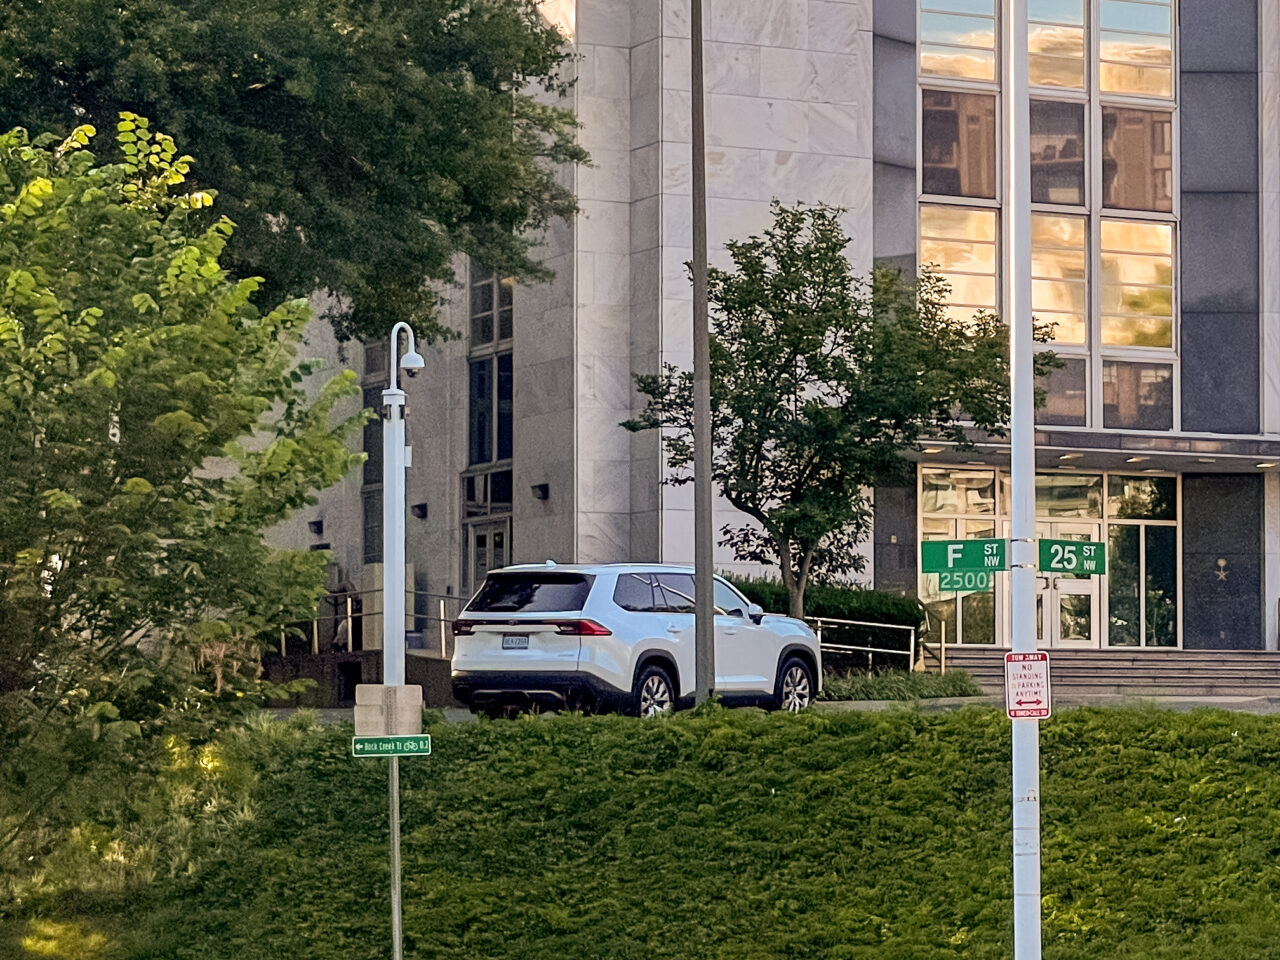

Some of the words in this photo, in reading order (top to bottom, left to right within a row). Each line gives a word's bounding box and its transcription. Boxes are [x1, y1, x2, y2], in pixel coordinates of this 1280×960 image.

[947, 544, 964, 568] F
[984, 543, 998, 555] ST
[984, 556, 1000, 567] NW
[1050, 544, 1077, 569] 25
[1083, 545, 1096, 557] ST
[1083, 559, 1096, 571] NW
[941, 572, 987, 589] 2500
[1012, 672, 1043, 680] STANDING
[1017, 681, 1045, 689] PARKING
